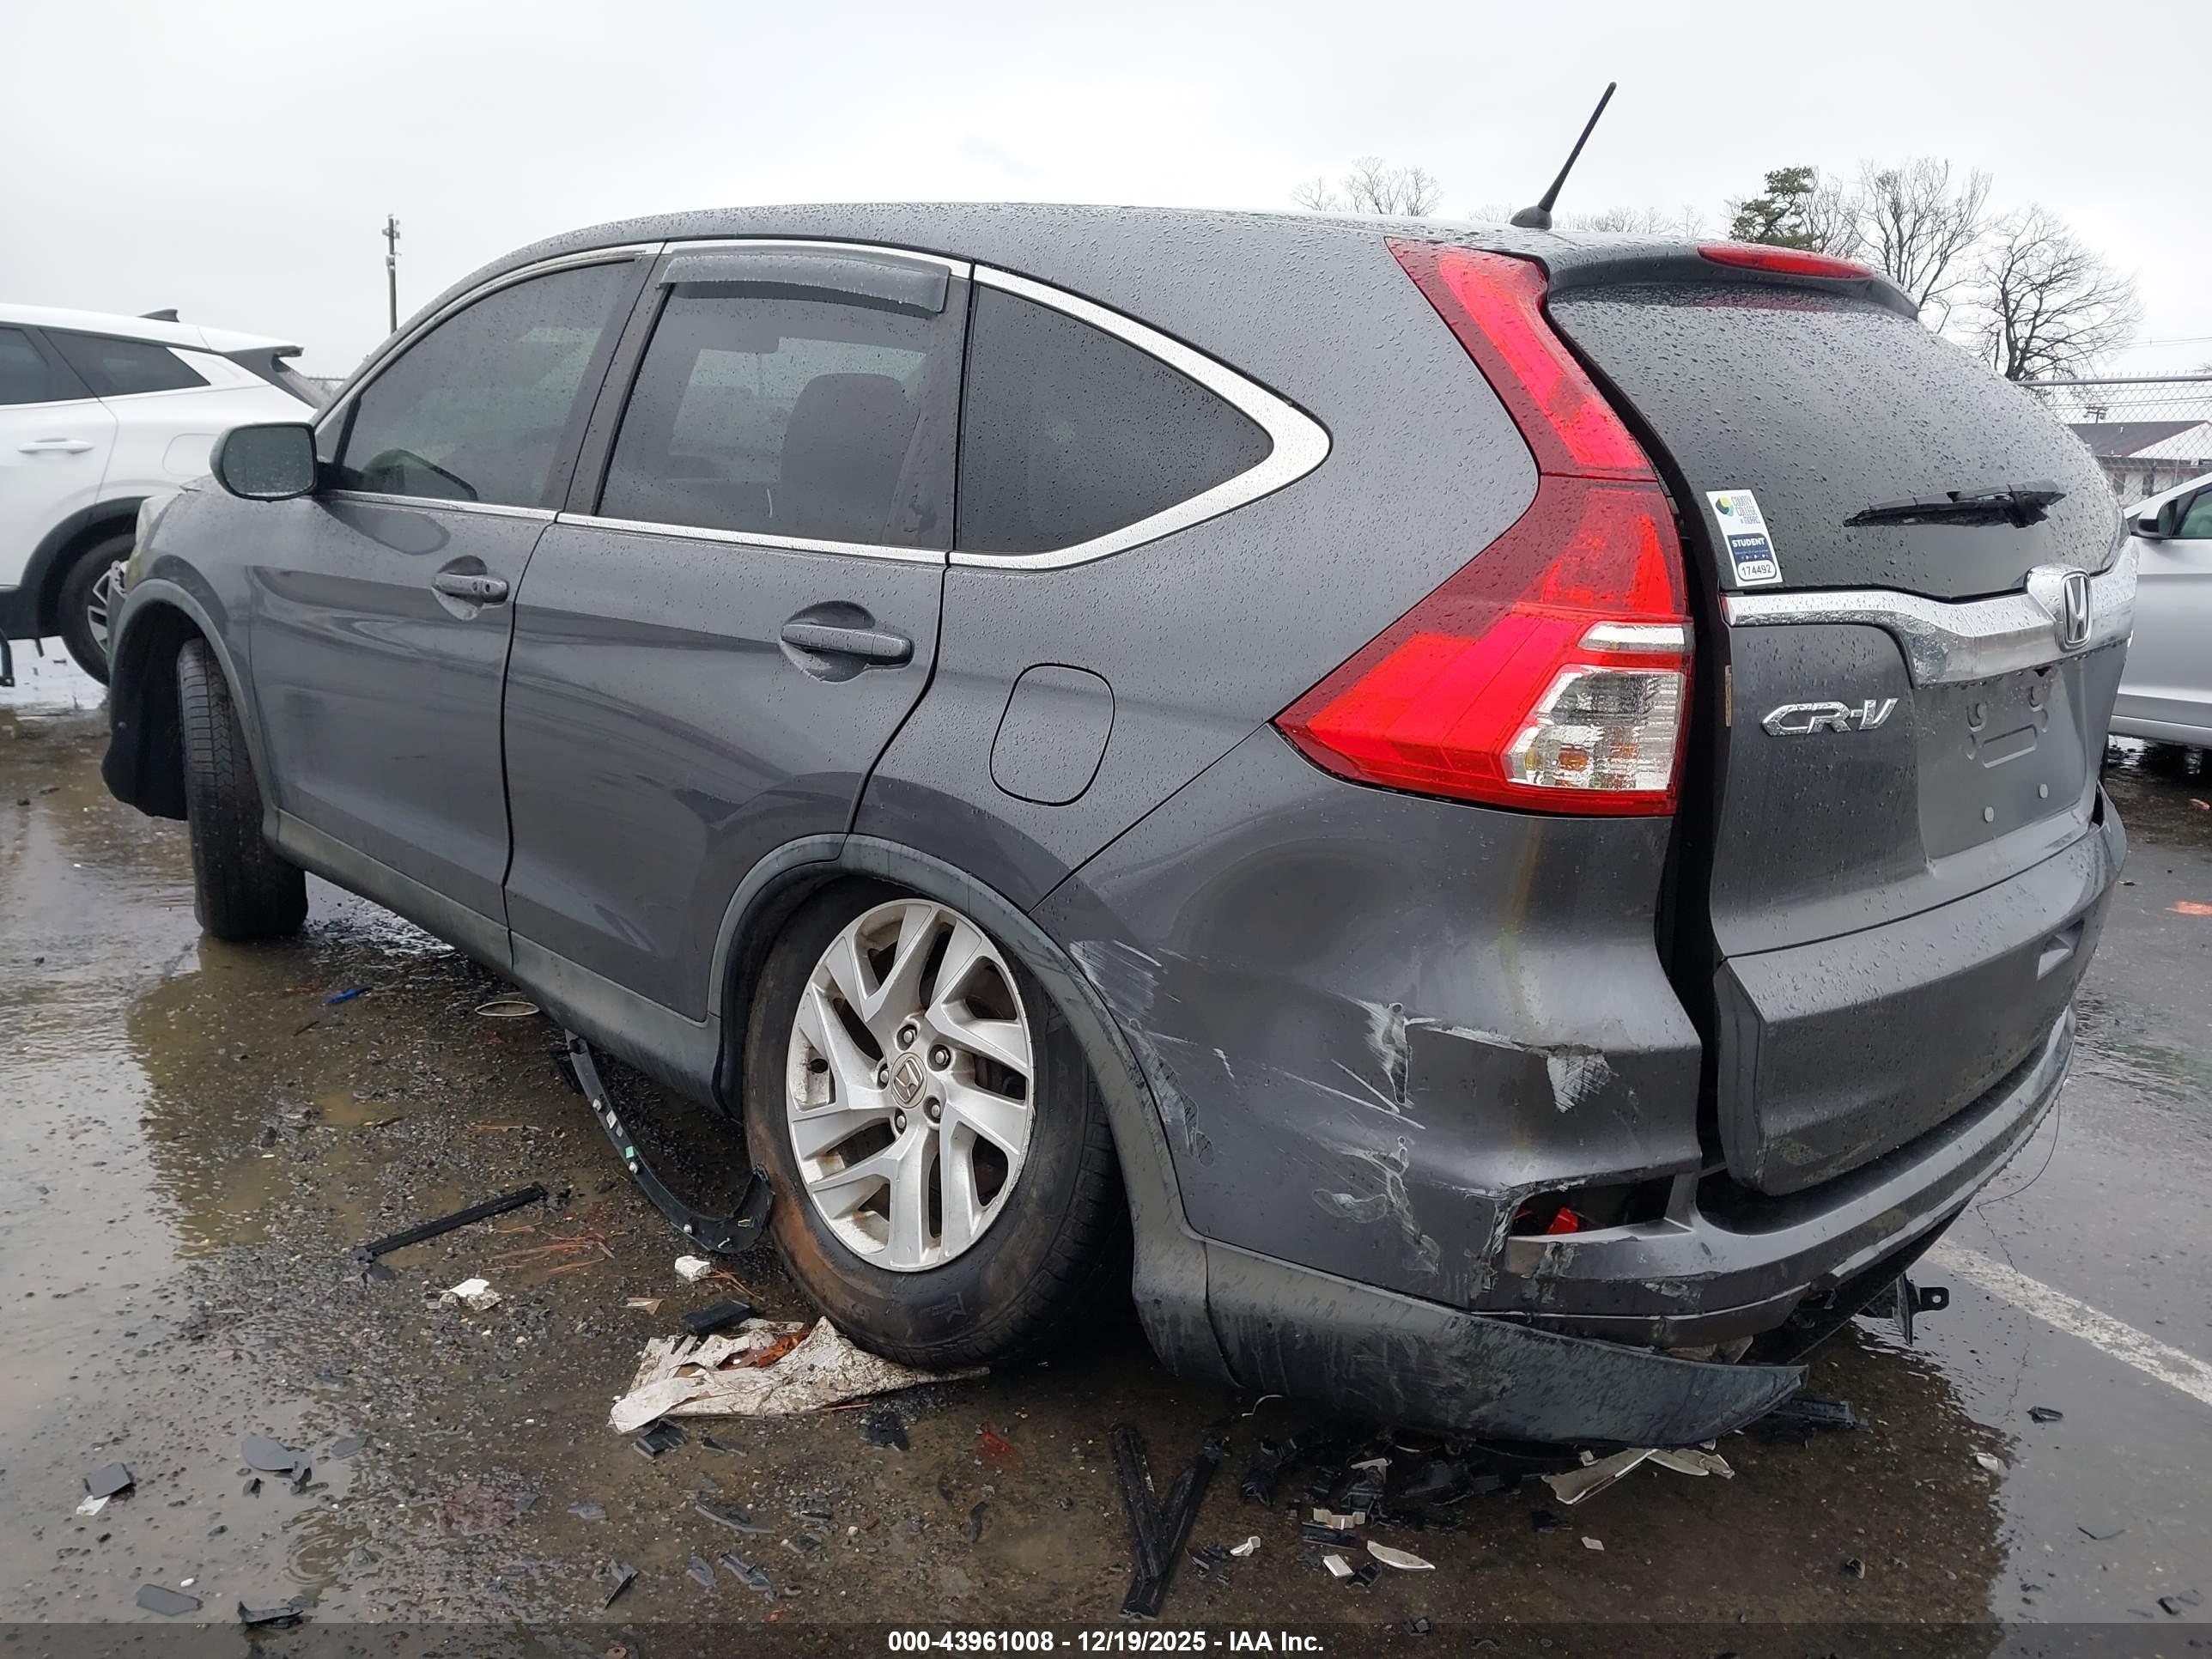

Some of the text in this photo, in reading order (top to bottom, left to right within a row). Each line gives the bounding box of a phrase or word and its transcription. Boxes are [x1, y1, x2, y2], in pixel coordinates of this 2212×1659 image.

[1731, 538, 1765, 548] STUDENT
[1741, 564, 1772, 576] 174492
[1761, 697, 1899, 737] CR-V
